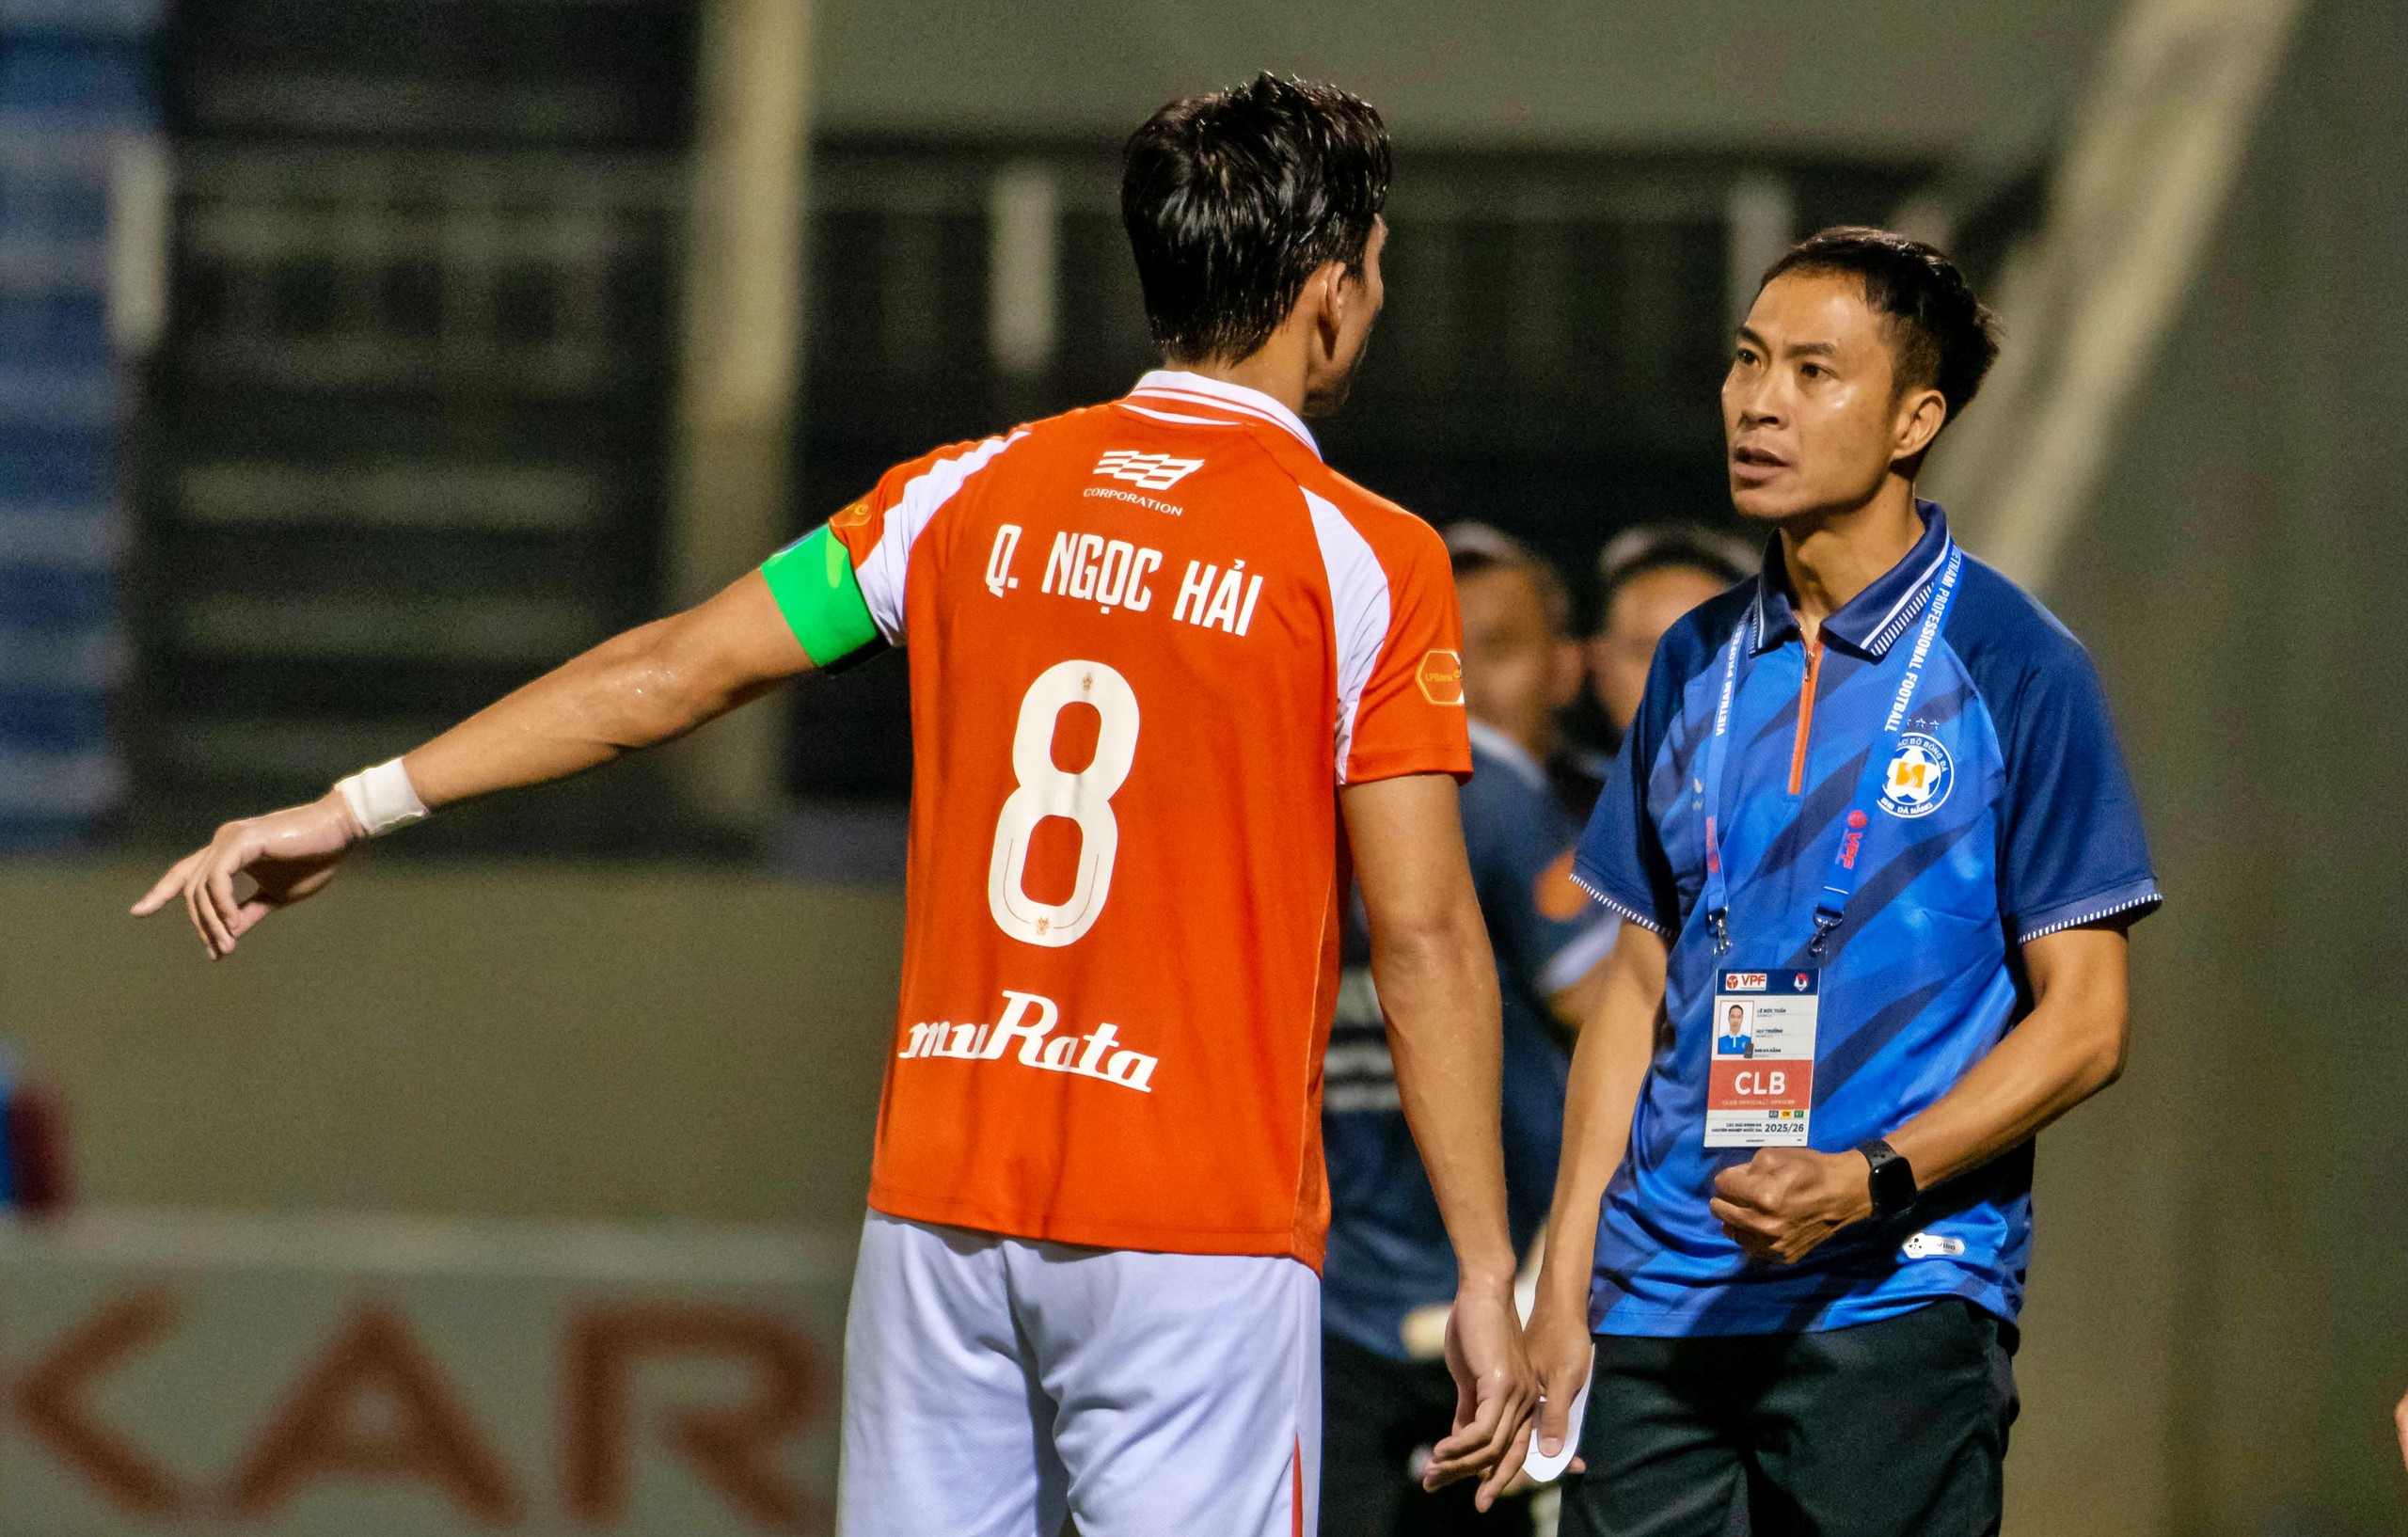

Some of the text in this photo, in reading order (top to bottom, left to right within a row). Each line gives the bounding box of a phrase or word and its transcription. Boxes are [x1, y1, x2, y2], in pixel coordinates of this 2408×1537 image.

[1083, 487, 1183, 516] CORPORATION
[985, 524, 1263, 637] Q. NGỌC HẢI
[1909, 587, 1950, 669] PROFESSIONAL
[1716, 680, 1732, 737] VIETNAM
[1884, 672, 1918, 732] FOOTBALL
[988, 659, 1140, 947] 8
[1741, 974, 1766, 987] VPF
[898, 990, 1158, 1093] muRata
[1735, 1071, 1785, 1095] CLB
[1765, 1123, 1804, 1133] 2025/26
